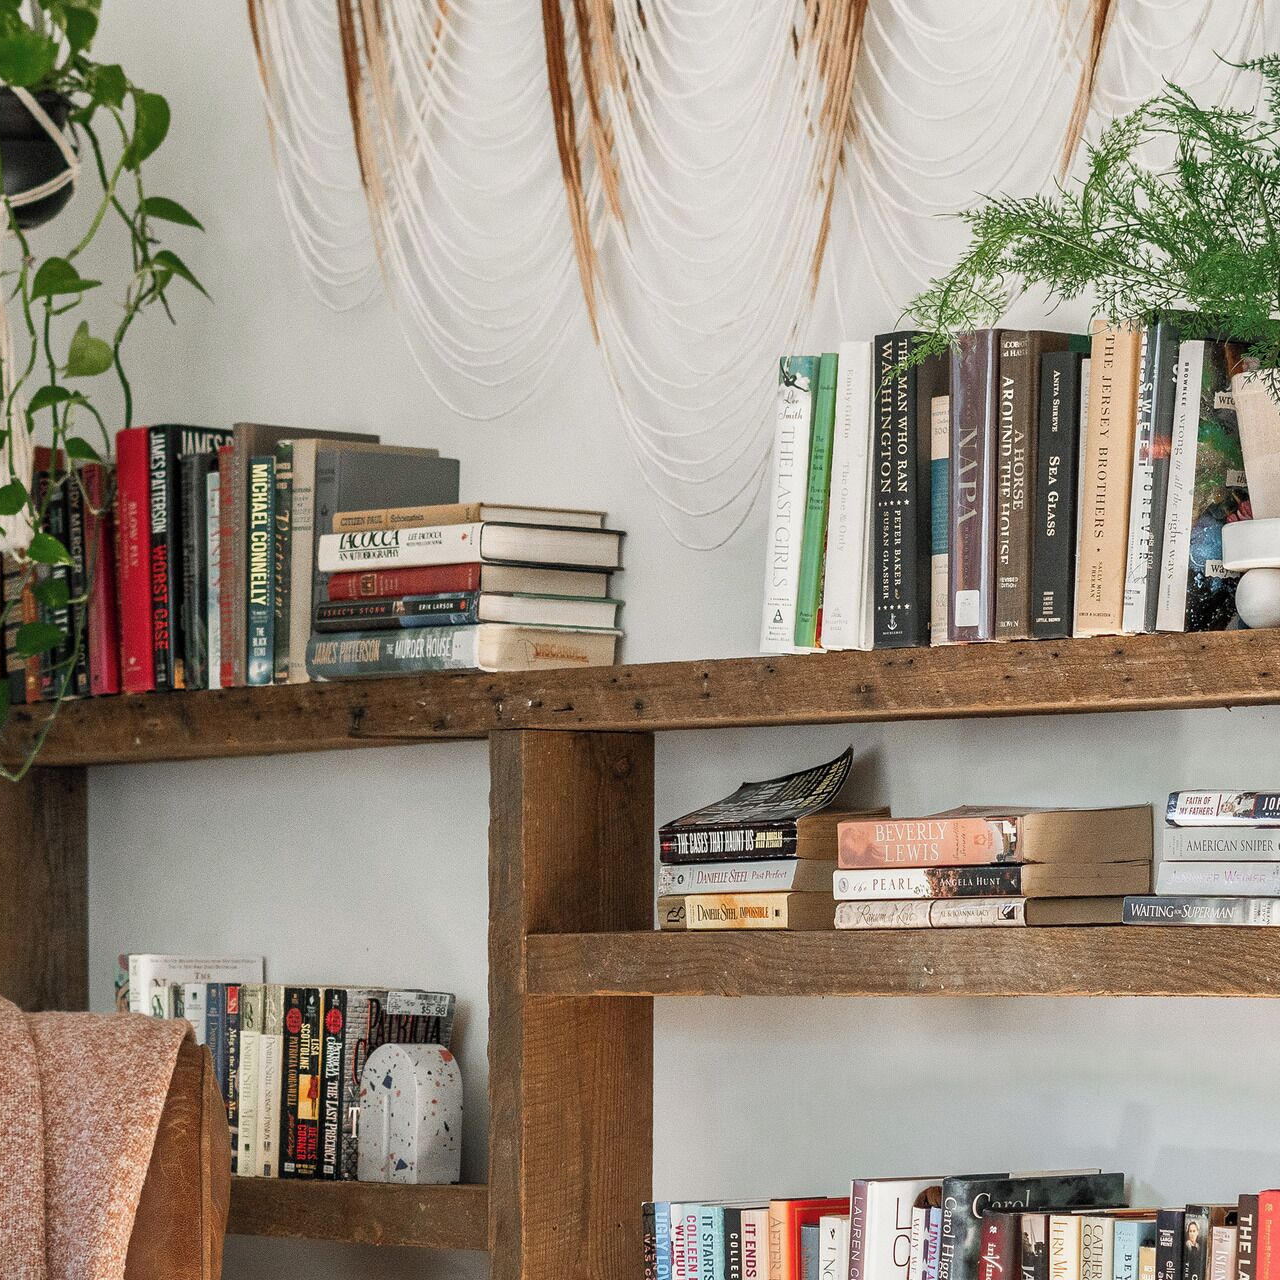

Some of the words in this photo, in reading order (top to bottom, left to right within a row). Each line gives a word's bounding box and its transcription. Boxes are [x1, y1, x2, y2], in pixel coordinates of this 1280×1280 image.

[897, 338, 908, 370] THE
[1104, 334, 1116, 369] THE
[897, 375, 908, 412] MAN
[1180, 361, 1190, 407] BROWNLEE
[881, 341, 893, 493] WASHINGTON
[1099, 374, 1113, 438] JERSEY
[150, 431, 166, 472] JAMES
[897, 414, 908, 455] WHO
[1014, 429, 1024, 441] A
[897, 458, 908, 493] RAN
[956, 428, 978, 527] NAPA
[1012, 448, 1024, 510] HORSE
[1093, 446, 1110, 540] BROTHERS
[151, 474, 167, 534] PATTERSON
[251, 463, 268, 529] MICHAEL
[894, 509, 902, 545] PETER
[152, 543, 168, 603] WORST
[250, 532, 268, 606] CONNELLY
[893, 547, 902, 586] BAKER
[1089, 564, 1097, 601] FREEMAN
[418, 603, 431, 611] ERIK
[432, 602, 454, 610] LARSON
[153, 609, 169, 651] CASE
[677, 833, 689, 855] THE
[689, 832, 708, 854] CASES
[708, 831, 724, 853] THAT
[724, 830, 745, 852] HAUNT
[745, 829, 754, 851] US
[875, 822, 948, 843] BEVERLY
[1186, 839, 1239, 852] AMERICAN
[1240, 839, 1274, 852] SNIPER
[885, 843, 940, 863] LEWIS
[421, 1006, 446, 1015] $5.98
[299, 1023, 311, 1070] SCOTTOLINE
[310, 1038, 319, 1056] LISA
[327, 1080, 338, 1097] THE
[297, 1124, 307, 1160] CORNER
[701, 1215, 713, 1229] IT
[744, 1223, 756, 1237] IT
[850, 1195, 863, 1261] LAUREN
[942, 1197, 958, 1240] Carol
[1238, 1214, 1253, 1253] THE
[686, 1215, 699, 1274] COLLEEN
[745, 1240, 757, 1280] ENDS
